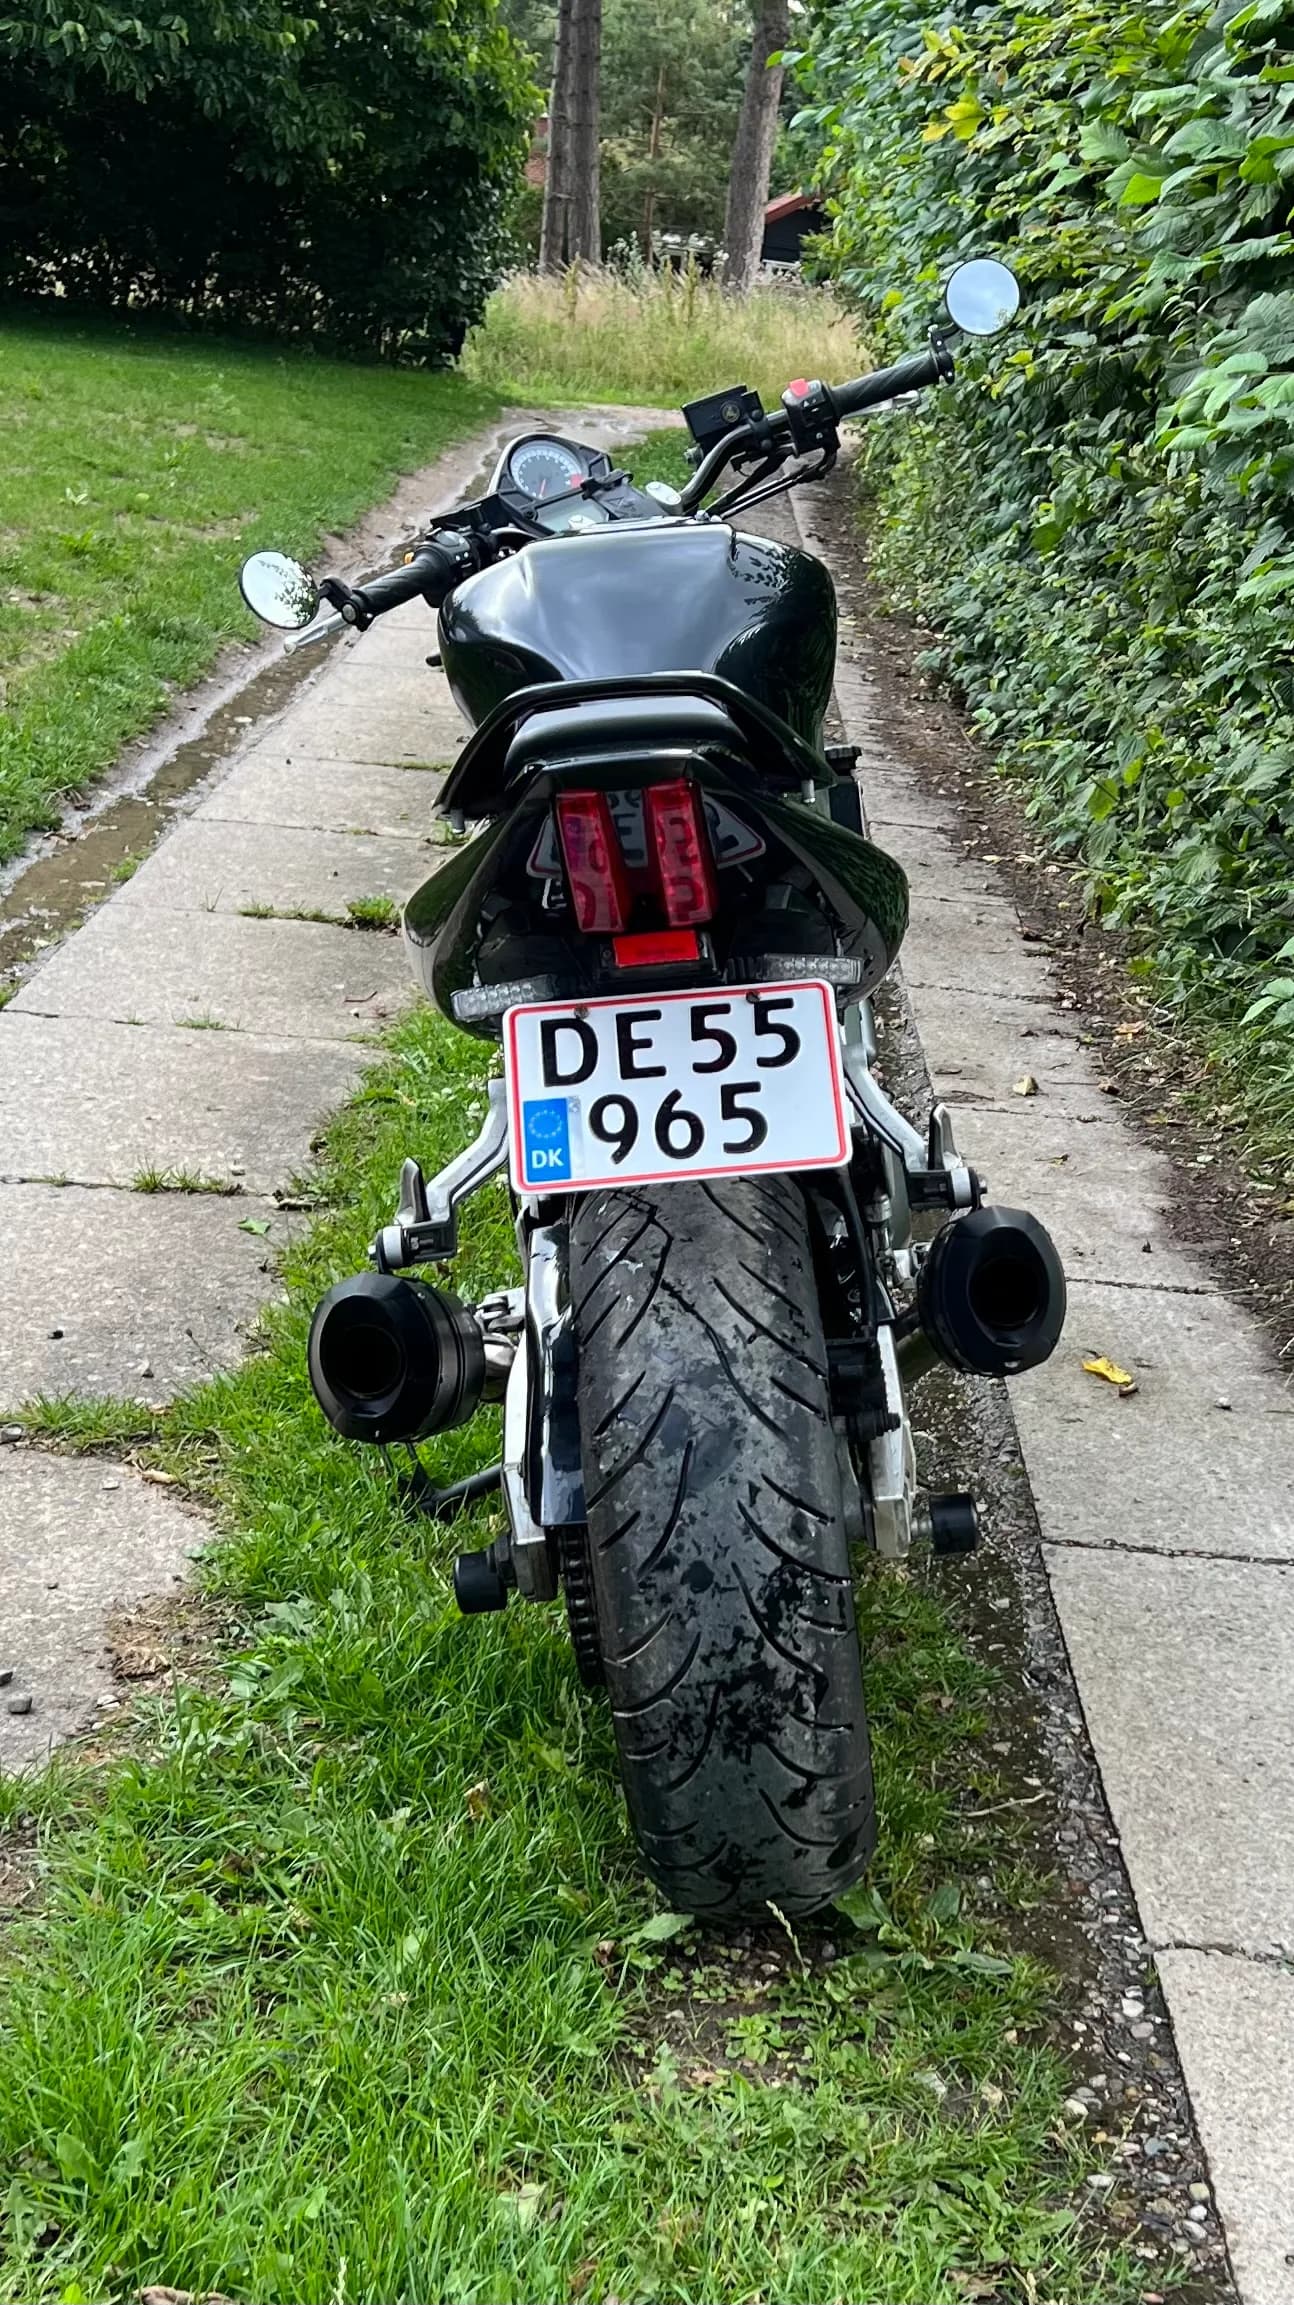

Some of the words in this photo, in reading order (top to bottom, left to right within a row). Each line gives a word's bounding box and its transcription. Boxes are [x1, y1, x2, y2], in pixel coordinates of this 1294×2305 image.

[540, 1009, 667, 1087] DE
[690, 998, 801, 1073] 55
[531, 1148, 564, 1168] DK
[588, 1081, 768, 1164] 965
